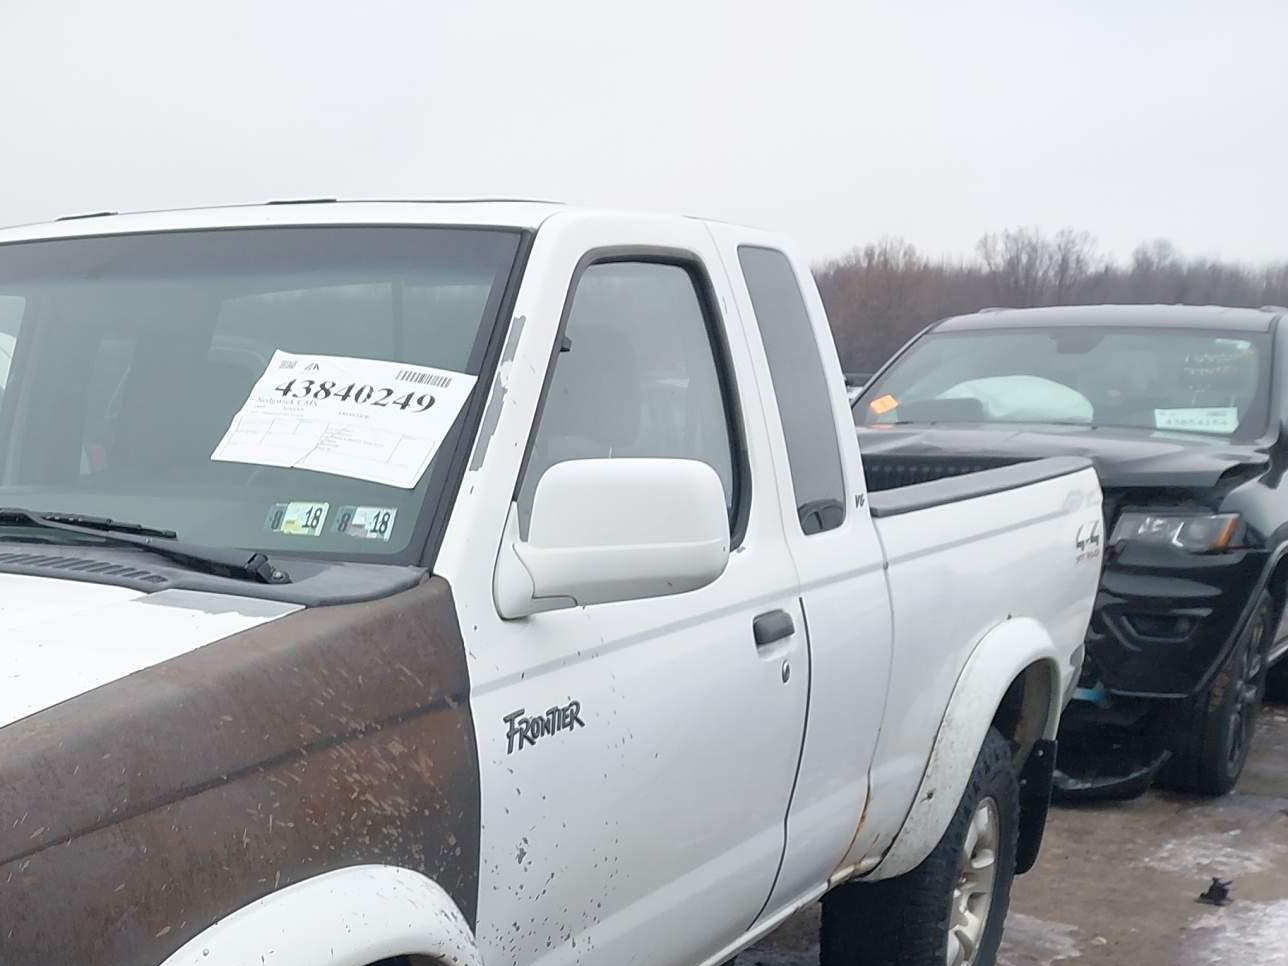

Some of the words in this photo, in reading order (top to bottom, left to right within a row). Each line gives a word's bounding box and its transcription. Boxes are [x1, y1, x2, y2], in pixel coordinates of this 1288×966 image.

[275, 378, 436, 413] 43840249
[302, 506, 323, 529] 18
[370, 511, 391, 534] 18
[503, 700, 585, 755] FRONTIER
